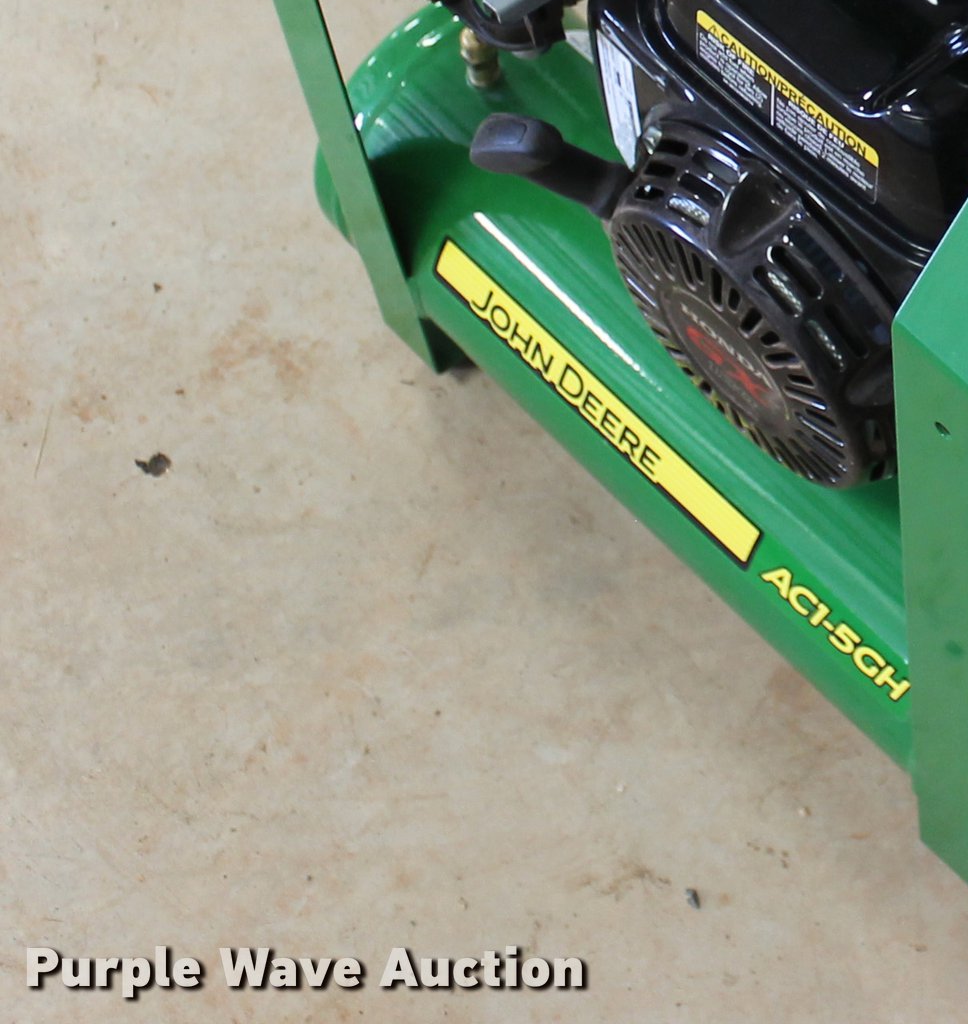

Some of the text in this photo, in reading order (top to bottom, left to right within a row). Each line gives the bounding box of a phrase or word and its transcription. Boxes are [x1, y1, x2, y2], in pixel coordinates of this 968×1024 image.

[721, 32, 865, 158] CAUTION/PRÉCAUTION
[471, 289, 555, 373] JOHN
[557, 363, 664, 476] DEERE
[680, 303, 773, 388] HONDA
[759, 566, 912, 699] AC1-5GH
